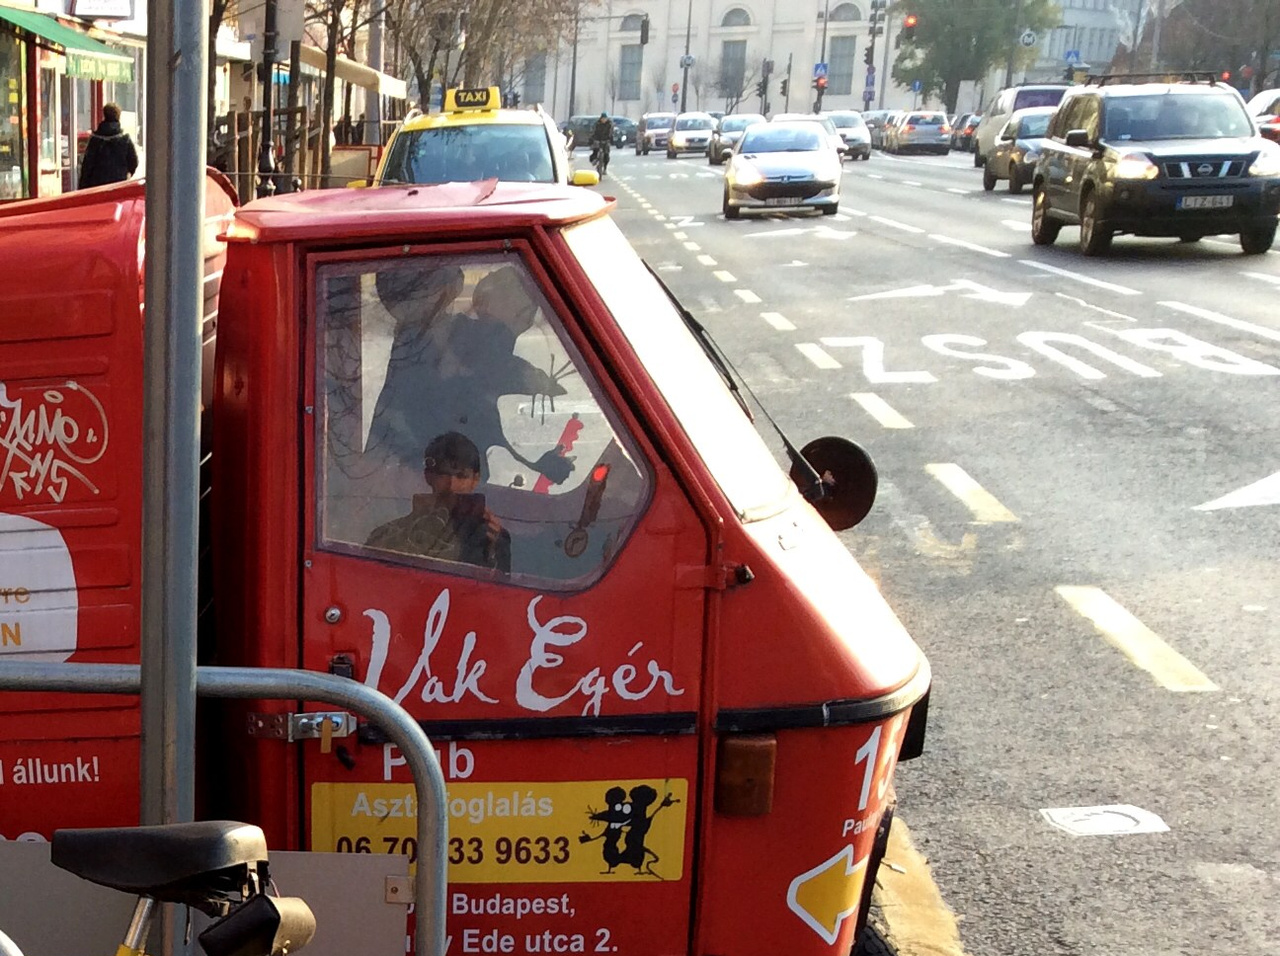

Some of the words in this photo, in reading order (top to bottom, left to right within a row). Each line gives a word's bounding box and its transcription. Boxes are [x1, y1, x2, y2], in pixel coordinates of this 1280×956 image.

[459, 91, 487, 103] TAXI
[363, 588, 499, 705] Vak
[515, 594, 685, 717] Egér
[12, 756, 101, 785] állunk!
[382, 741, 476, 782] Pb
[351, 791, 554, 824] Asztoglalás
[336, 836, 372, 854] 06
[382, 836, 418, 864] 70
[448, 836, 484, 865] 33
[495, 836, 571, 865] 9633
[452, 893, 576, 920] Budapest,
[463, 929, 515, 953] Ede
[525, 930, 585, 954] utca
[595, 927, 619, 953] 2.
